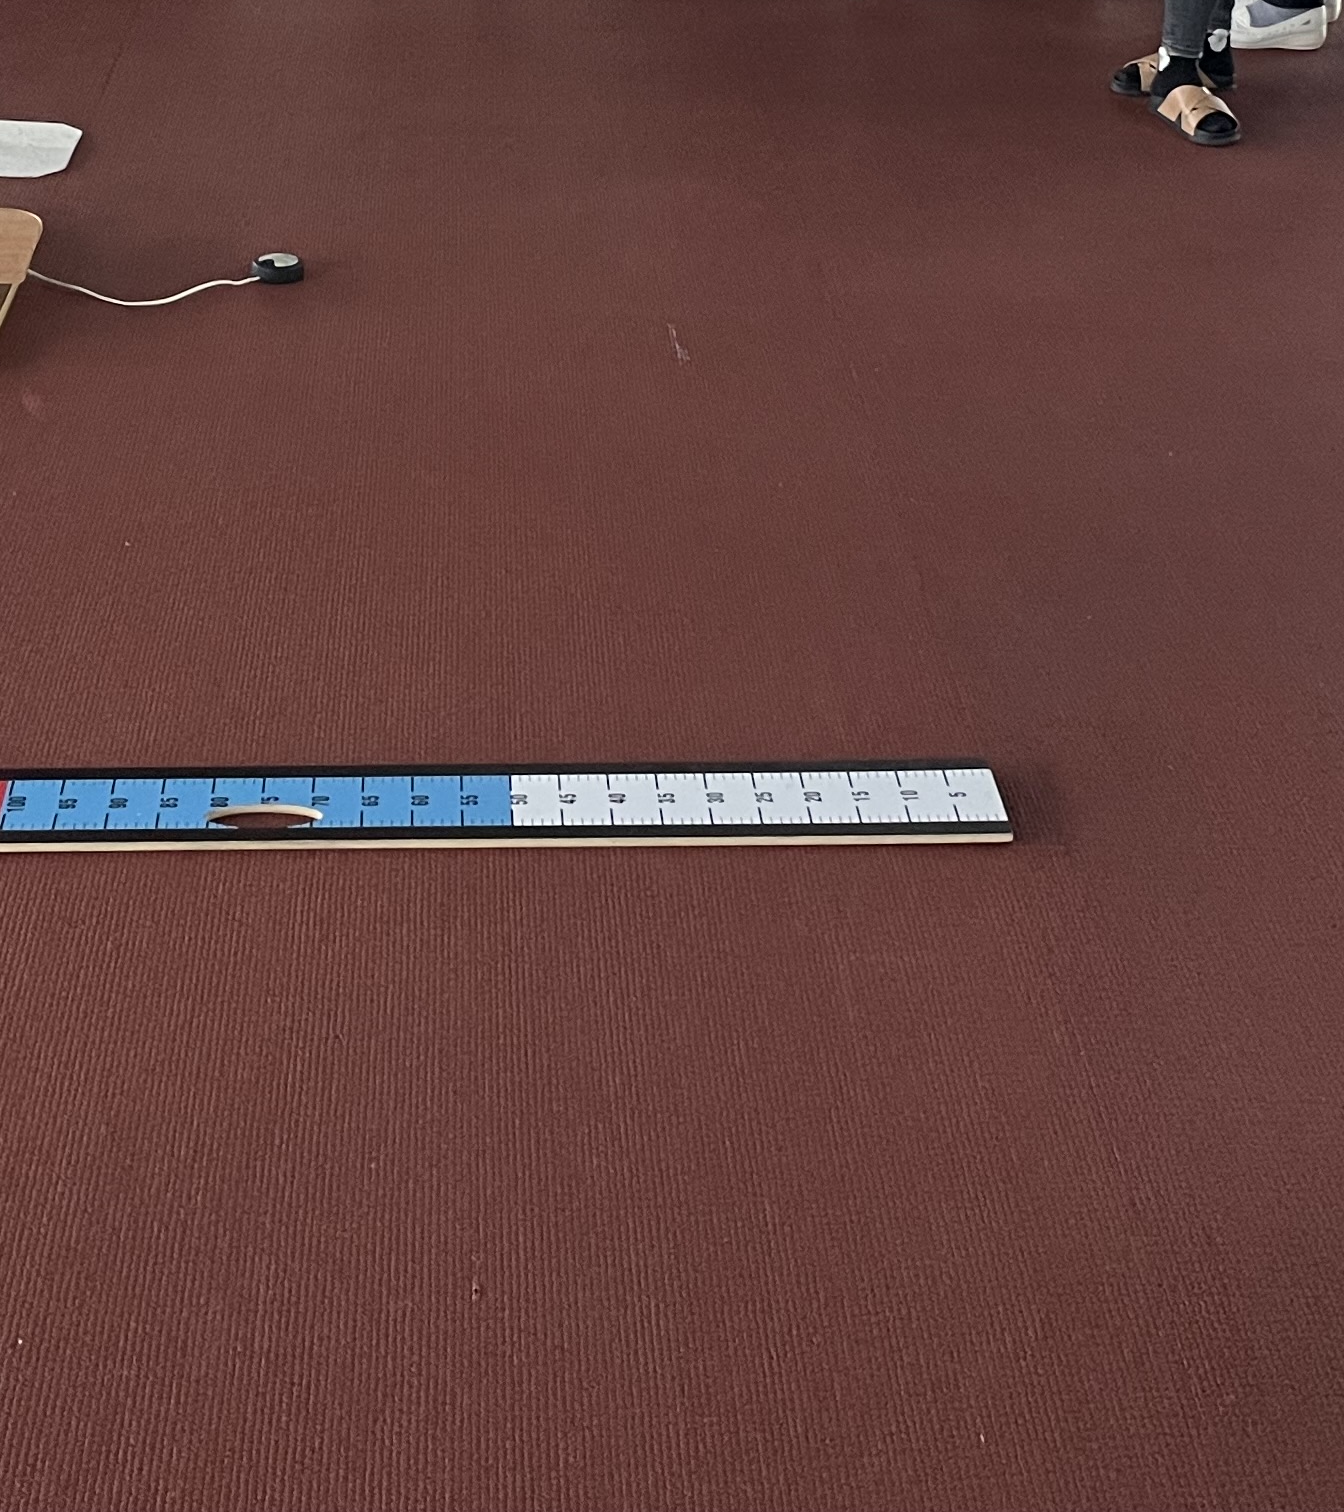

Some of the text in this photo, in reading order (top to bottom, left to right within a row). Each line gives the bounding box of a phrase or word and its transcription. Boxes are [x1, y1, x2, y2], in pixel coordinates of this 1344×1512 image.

[210, 796, 229, 808] 80
[312, 795, 330, 806] 70
[362, 795, 380, 806] 65
[411, 794, 429, 806] 60
[460, 794, 479, 806] 55
[510, 794, 528, 805] 50
[559, 793, 577, 805] 45
[608, 792, 626, 805] 40
[658, 792, 676, 804] 35
[707, 792, 725, 804] 30
[756, 791, 774, 804] 25
[804, 791, 822, 804] 20
[851, 790, 869, 803] 15
[900, 790, 918, 802] 10
[7, 795, 27, 813] 100
[58, 798, 78, 810] 95
[108, 797, 128, 809] 90
[160, 797, 179, 809] 85
